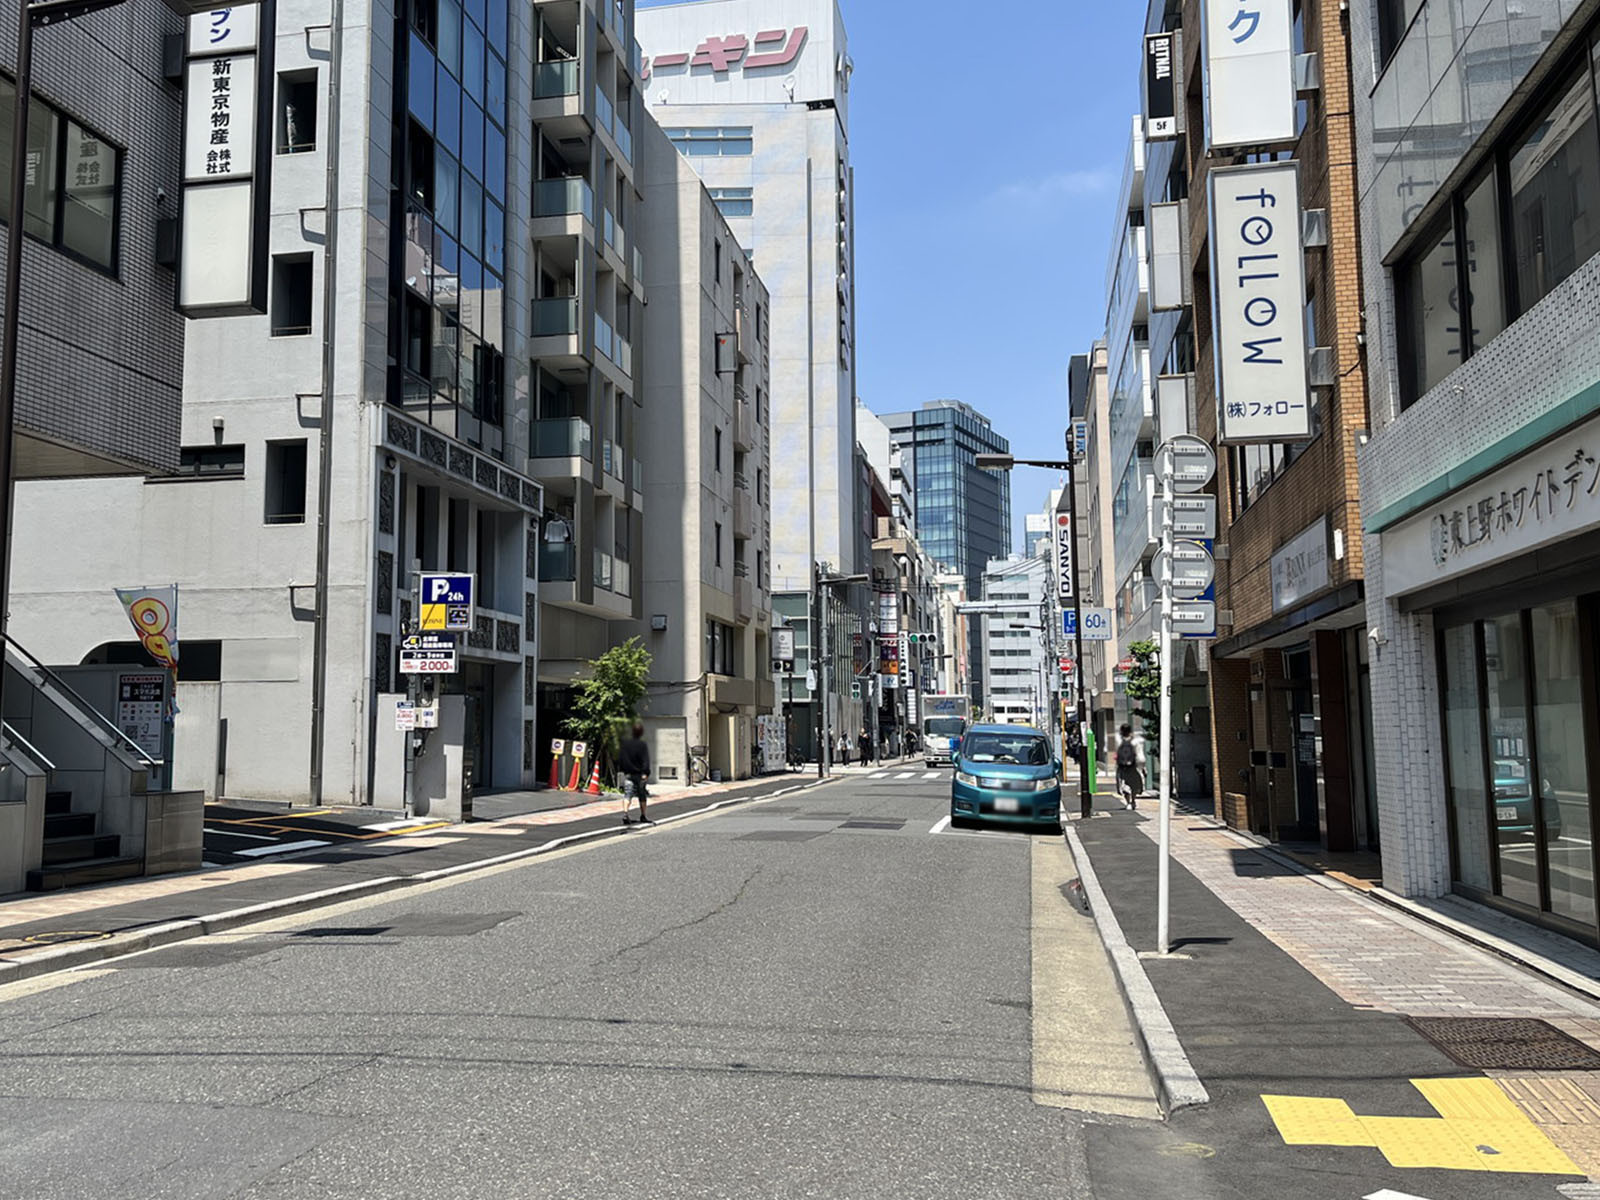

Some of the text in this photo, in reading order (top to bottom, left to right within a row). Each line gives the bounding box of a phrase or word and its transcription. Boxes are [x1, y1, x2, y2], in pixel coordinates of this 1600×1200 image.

[1227, 0, 1261, 44] ク
[210, 58, 232, 145] 新東京物産
[1156, 121, 1168, 131] 5F
[1058, 529, 1070, 593] SANYO
[431, 579, 464, 602] P 24h
